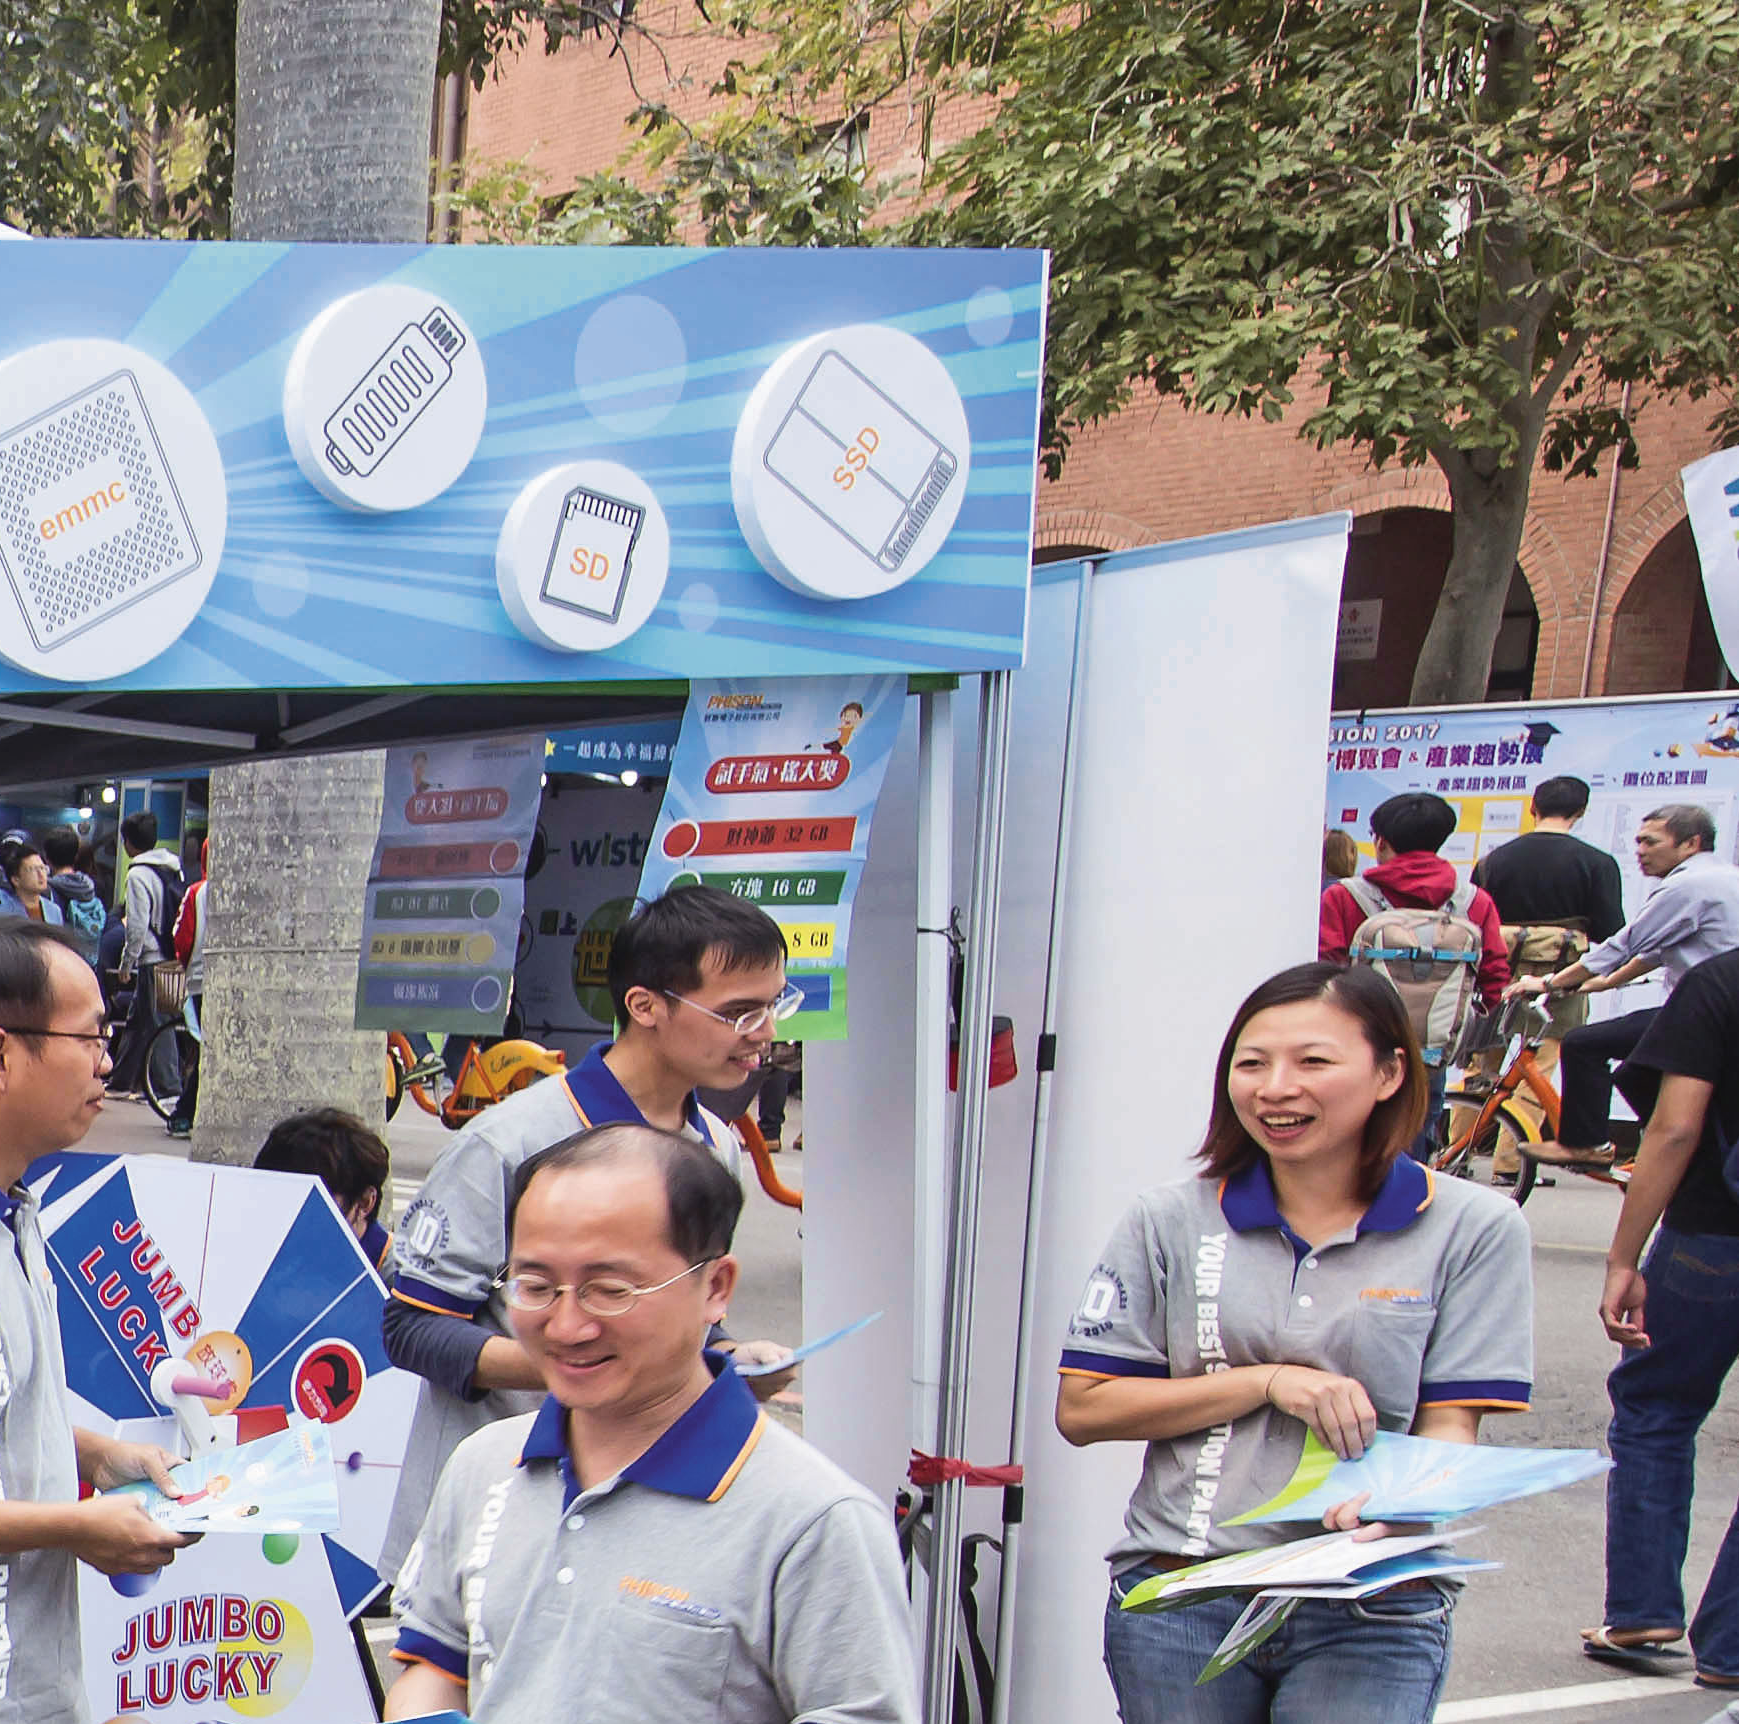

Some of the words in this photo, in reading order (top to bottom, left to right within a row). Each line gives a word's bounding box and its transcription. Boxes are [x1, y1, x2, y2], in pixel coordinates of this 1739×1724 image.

[831, 426, 882, 491] SSD
[569, 547, 611, 582] SD
[1383, 723, 1440, 742] 2017
[570, 831, 650, 867] wist
[771, 878, 790, 897] 16
[796, 878, 817, 897] GB
[809, 931, 829, 948] GB
[113, 1219, 203, 1339] JUMB
[1196, 1232, 1228, 1297] YOUR
[77, 1244, 169, 1376] LUCK
[1197, 1303, 1227, 1361] BEST
[465, 1475, 515, 1571] YOUR
[112, 1593, 285, 1665] JUMBO
[117, 1651, 283, 1715] LUCKY
